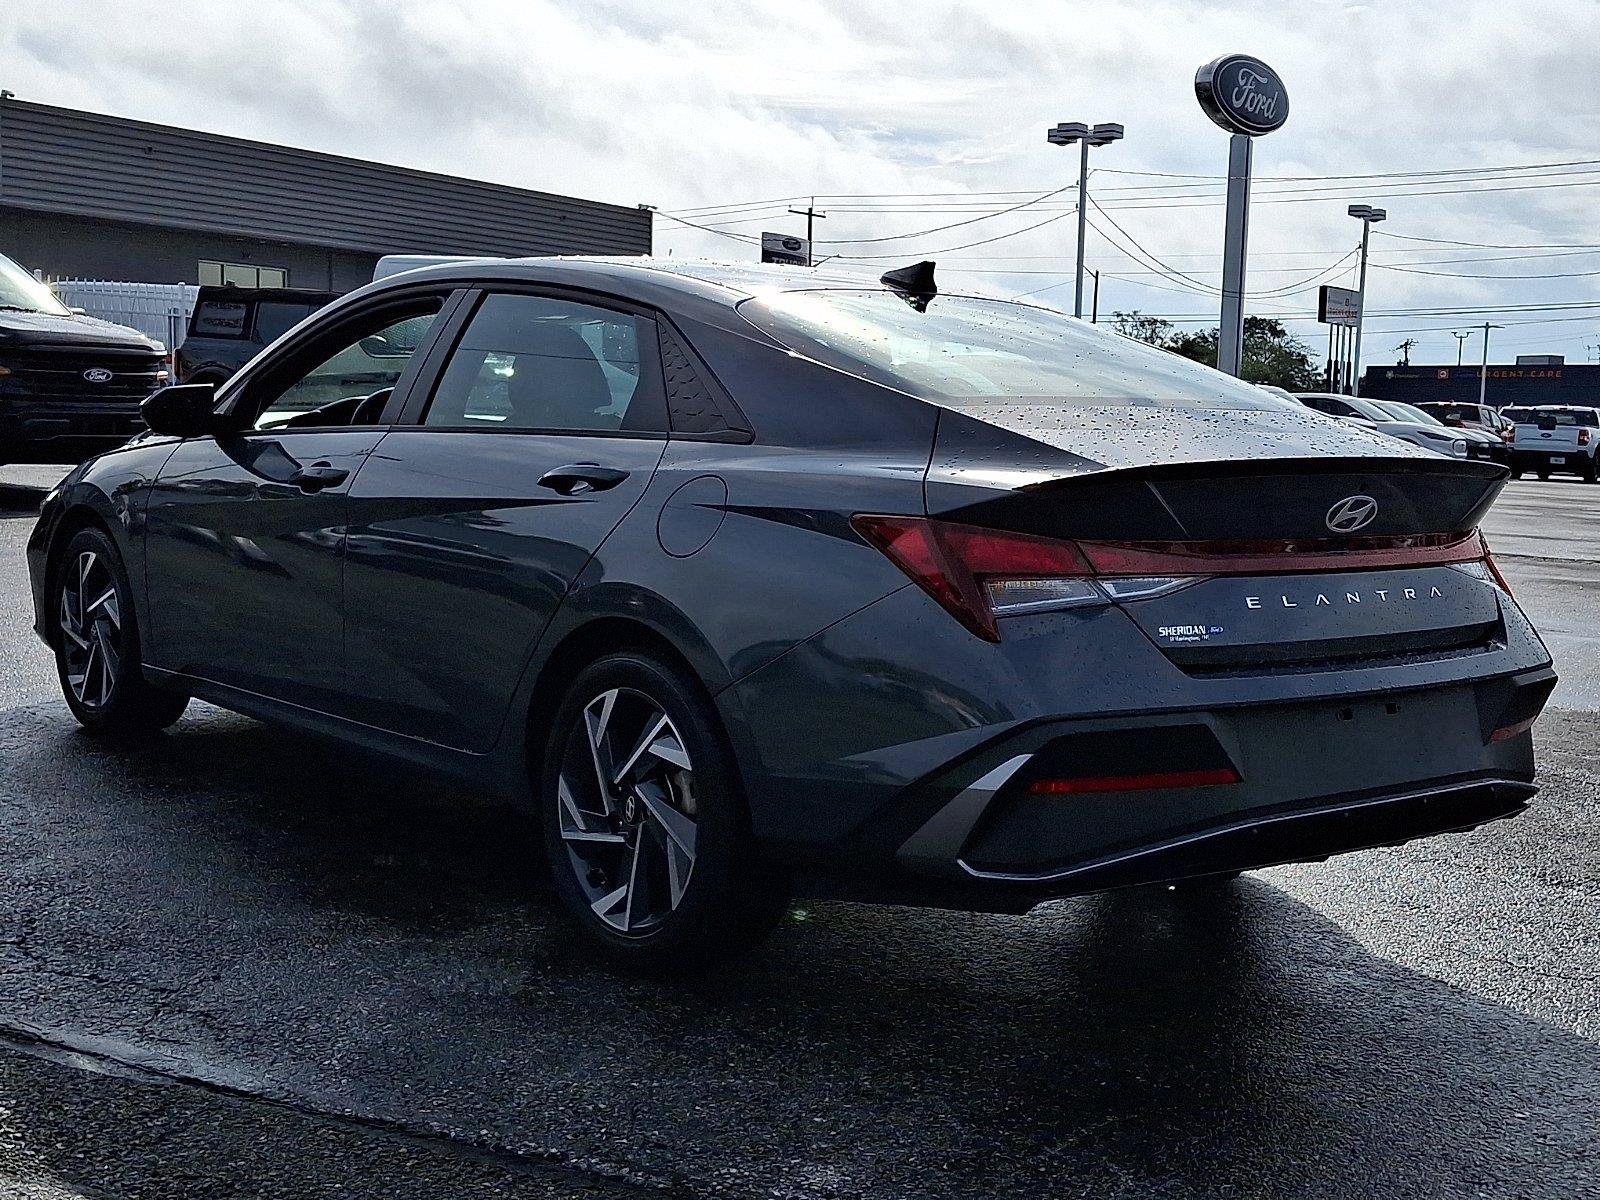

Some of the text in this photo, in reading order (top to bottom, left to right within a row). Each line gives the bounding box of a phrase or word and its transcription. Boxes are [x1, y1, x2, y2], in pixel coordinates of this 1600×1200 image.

[1232, 67, 1278, 119] Ford
[89, 371, 108, 380] Ford
[1476, 370, 1524, 378] URGENT
[1530, 370, 1563, 378] CARE
[1245, 586, 1442, 610] ELANTRA
[1158, 625, 1206, 637] SHERIDAN
